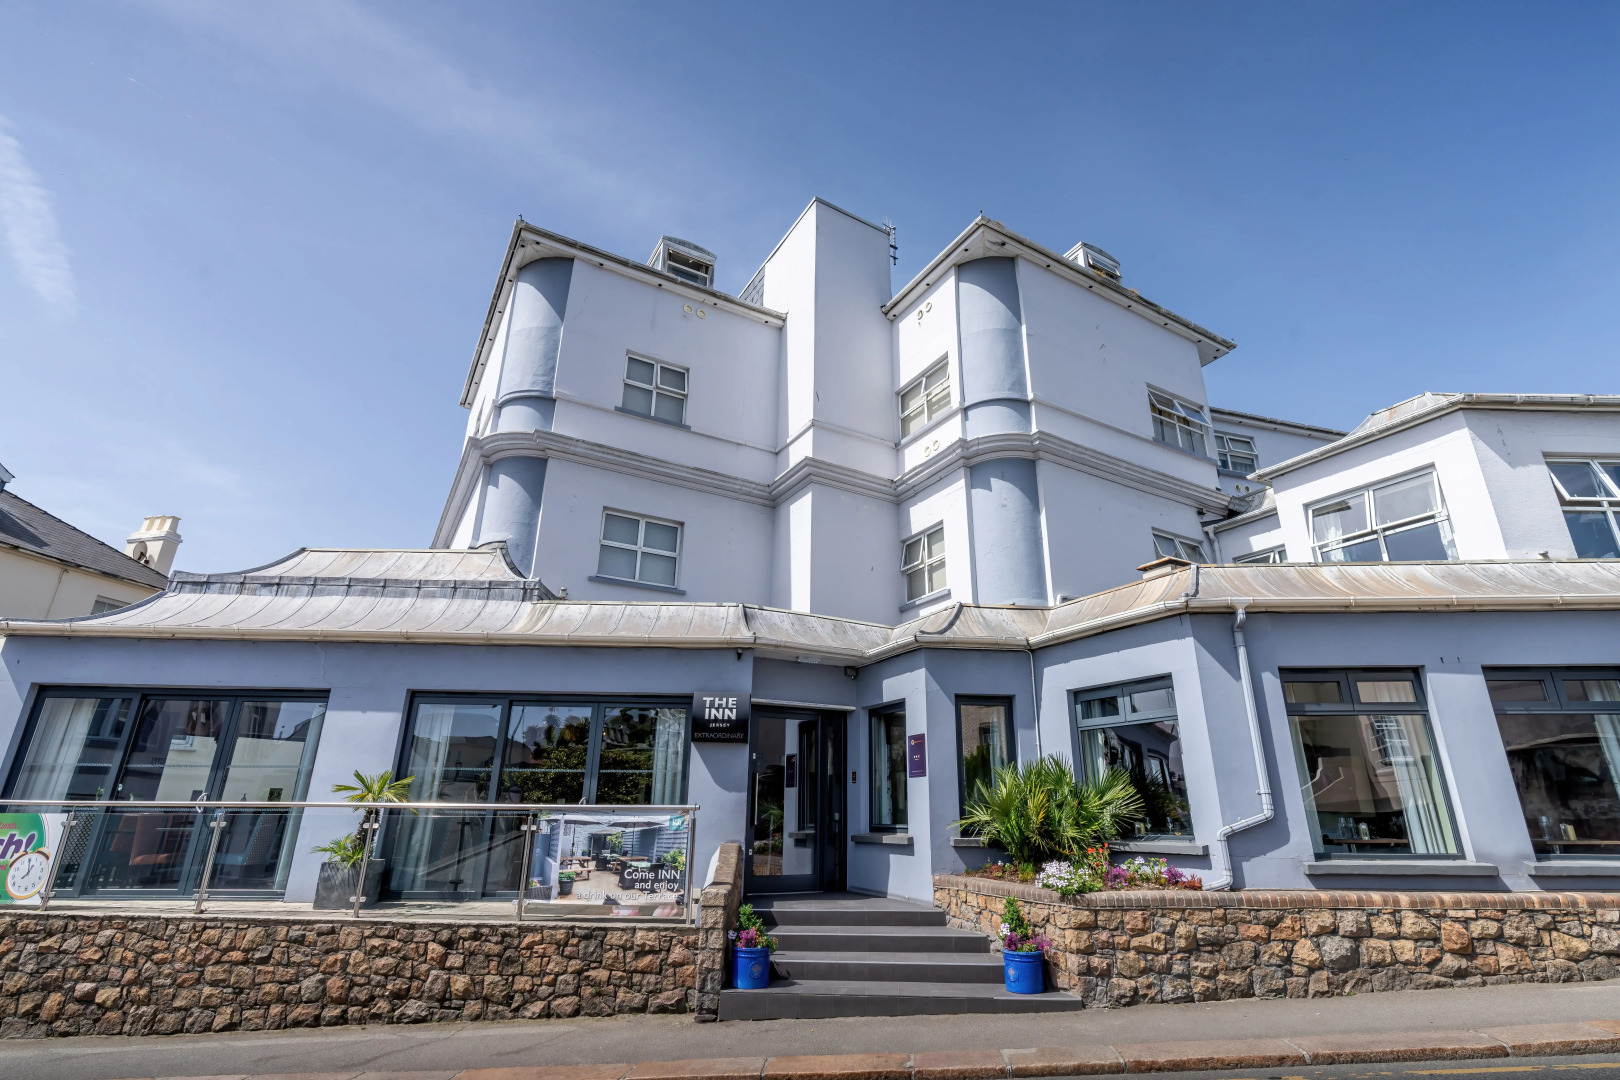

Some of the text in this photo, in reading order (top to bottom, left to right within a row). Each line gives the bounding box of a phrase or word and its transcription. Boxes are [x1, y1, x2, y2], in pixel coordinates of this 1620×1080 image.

[702, 696, 737, 708] THE
[704, 708, 736, 720] INN
[624, 869, 680, 880] Come INN
[634, 881, 679, 892] and enjoy
[584, 890, 607, 899] drink
[643, 891, 678, 900] Terrace
